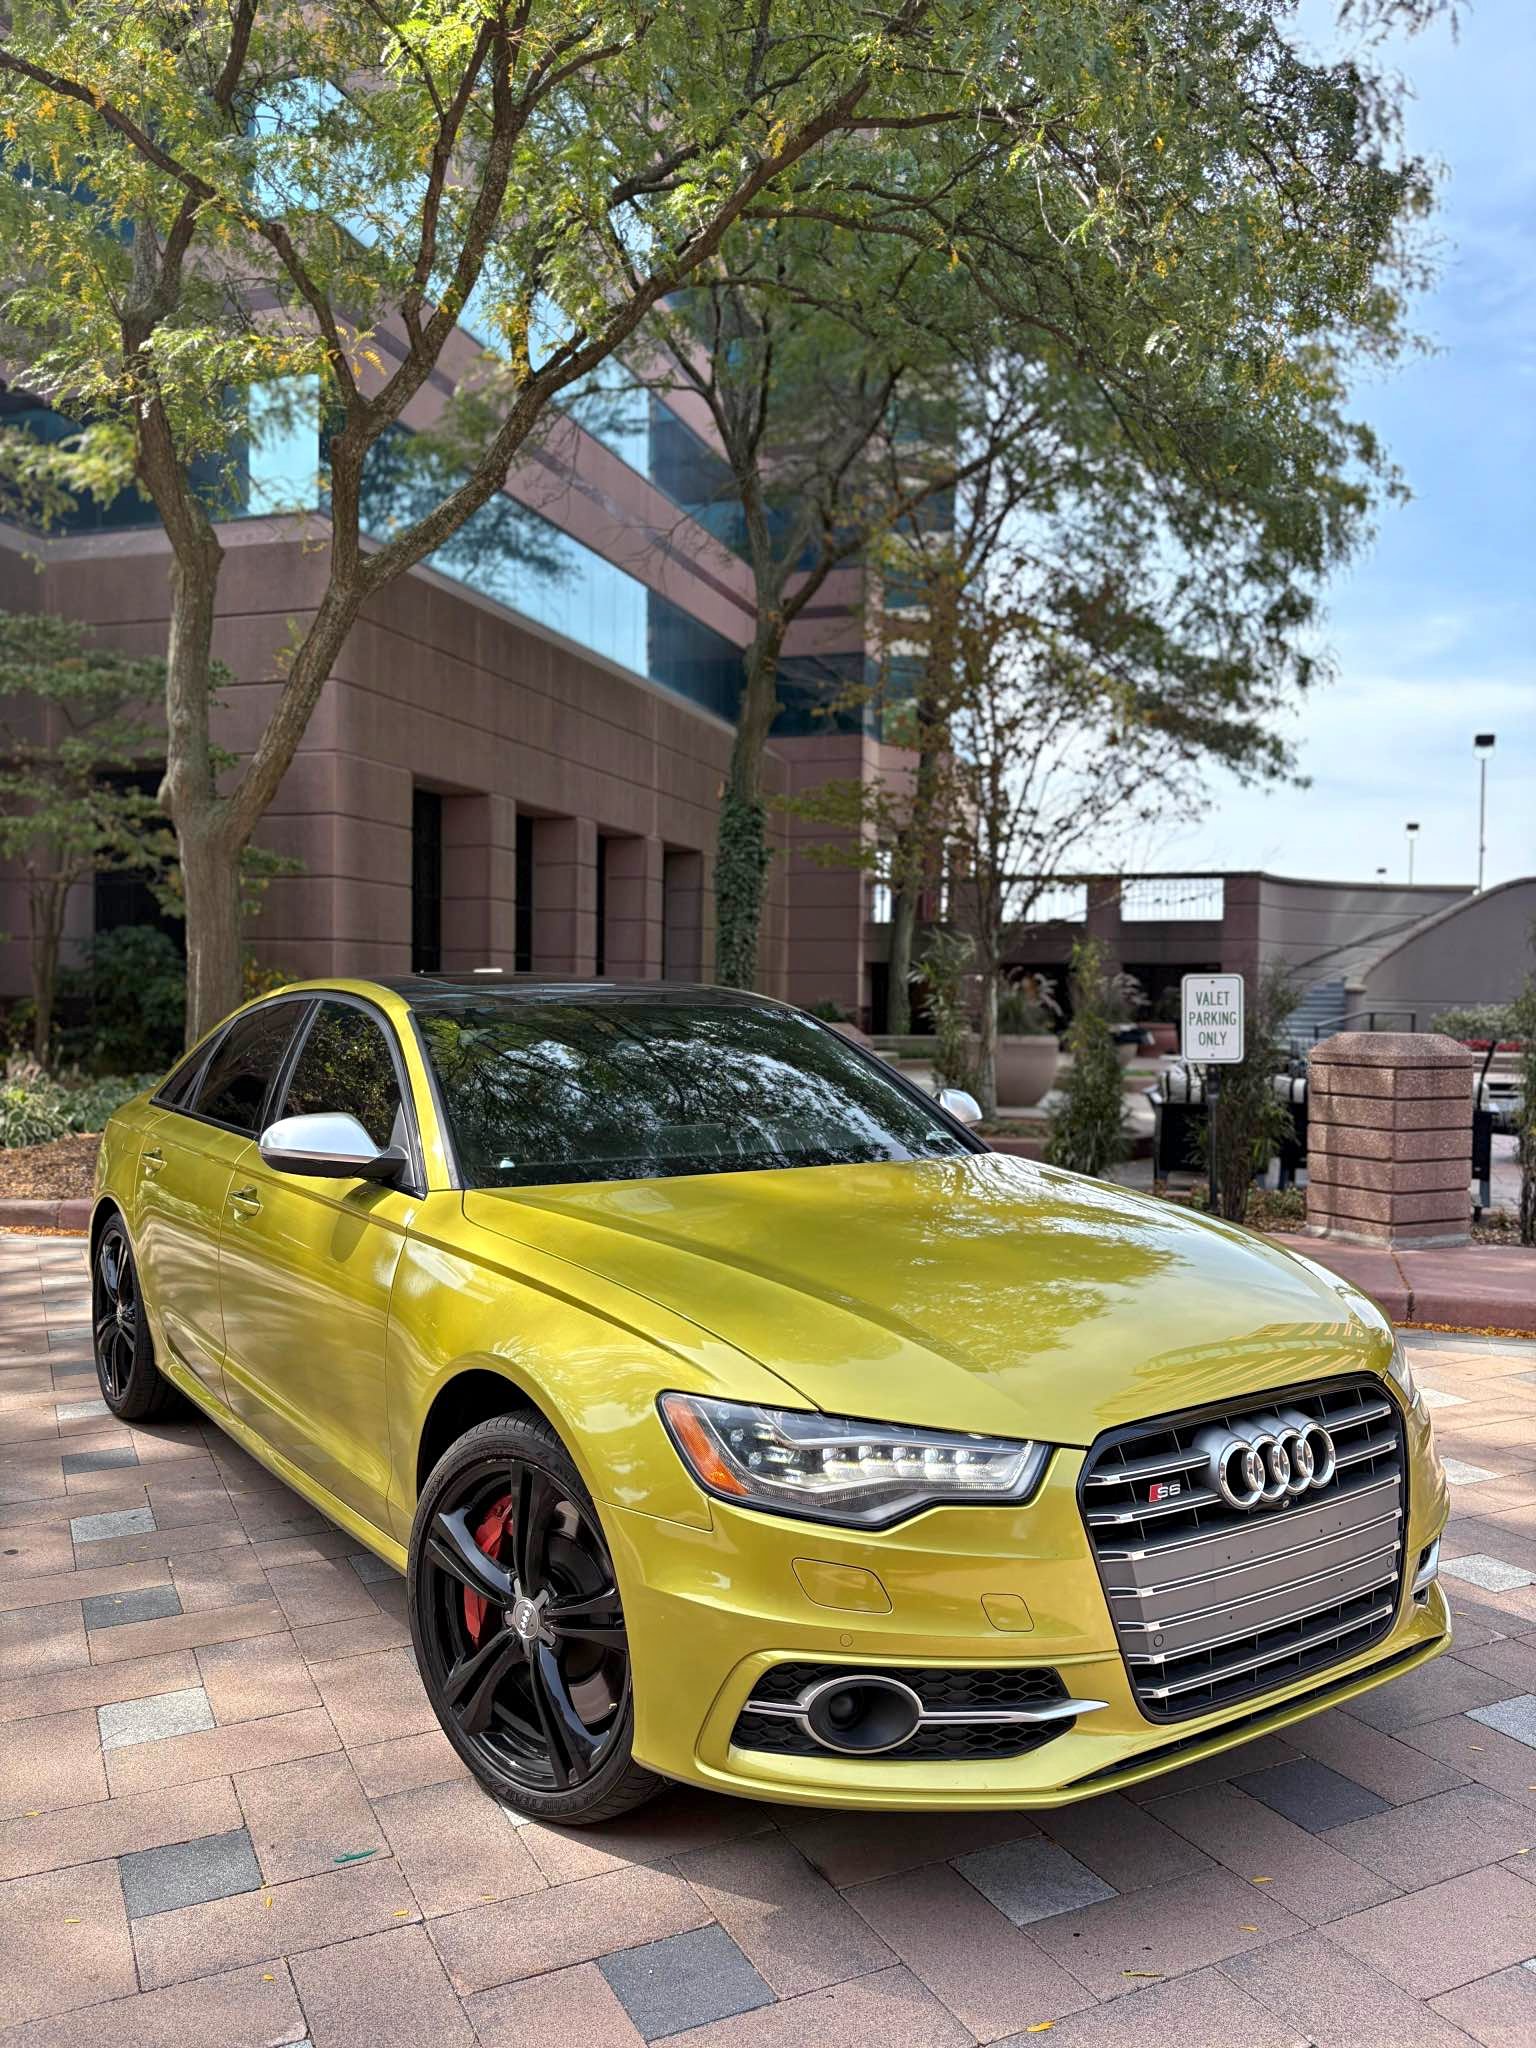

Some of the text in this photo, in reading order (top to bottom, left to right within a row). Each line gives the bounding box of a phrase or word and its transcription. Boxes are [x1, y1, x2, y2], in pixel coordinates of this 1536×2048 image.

[1195, 991, 1230, 1006] VALET
[1188, 1011, 1237, 1026] PARKING
[1198, 1031, 1227, 1046] ONLY
[1157, 1483, 1181, 1499] S6
